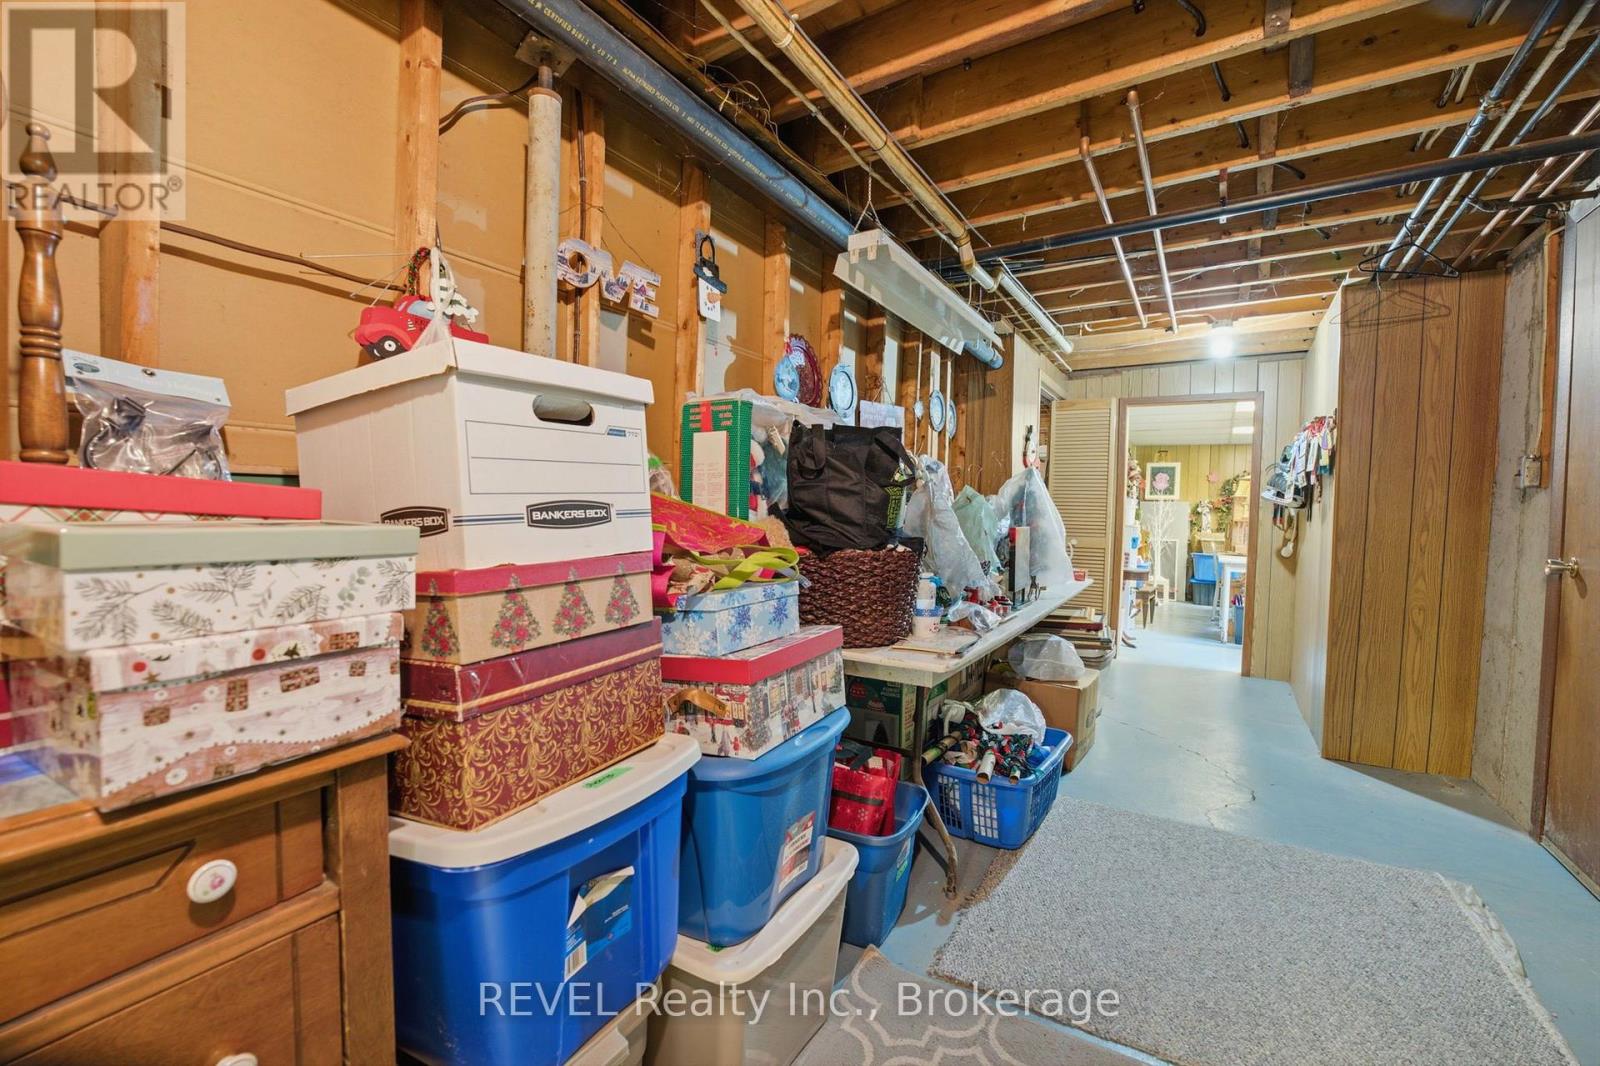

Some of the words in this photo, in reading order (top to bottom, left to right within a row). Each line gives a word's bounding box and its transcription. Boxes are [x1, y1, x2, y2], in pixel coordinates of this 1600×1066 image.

[557, 238, 662, 318] OVE
[532, 509, 585, 520] BANKERS
[586, 508, 607, 518] BOX
[423, 515, 444, 526] BOX
